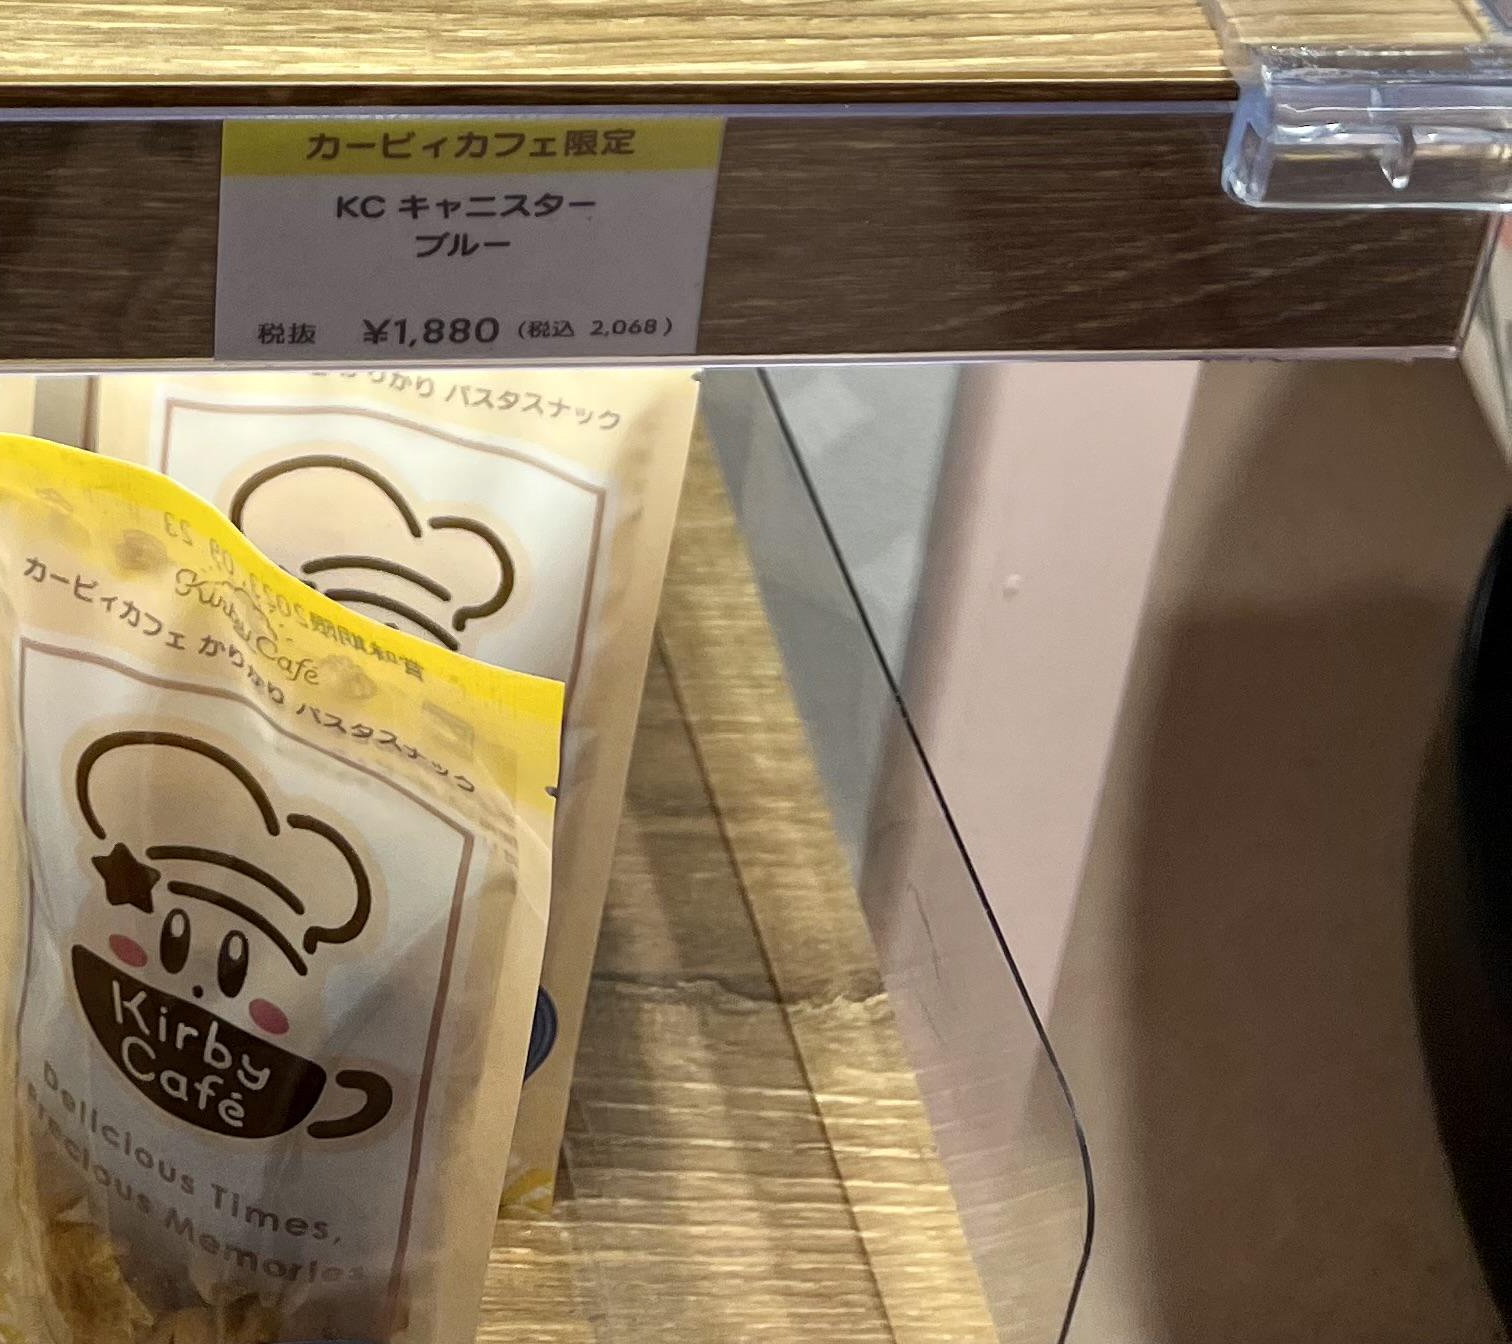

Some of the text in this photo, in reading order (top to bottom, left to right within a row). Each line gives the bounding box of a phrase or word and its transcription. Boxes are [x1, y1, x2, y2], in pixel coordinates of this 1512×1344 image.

[306, 128, 637, 161] カービィカフェ限定
[335, 192, 597, 220] KC キャニスター
[415, 232, 512, 259] ブルー
[257, 322, 317, 346] 税抜
[362, 317, 501, 349] ¥1,880
[444, 383, 624, 433] パスタスナック
[23, 555, 477, 795] カービィカフェ かりかり パスタスナック
[255, 634, 321, 686] Café
[109, 978, 272, 1092] Kirby
[119, 1036, 248, 1128] Café
[43, 1059, 195, 1195] Delicious
